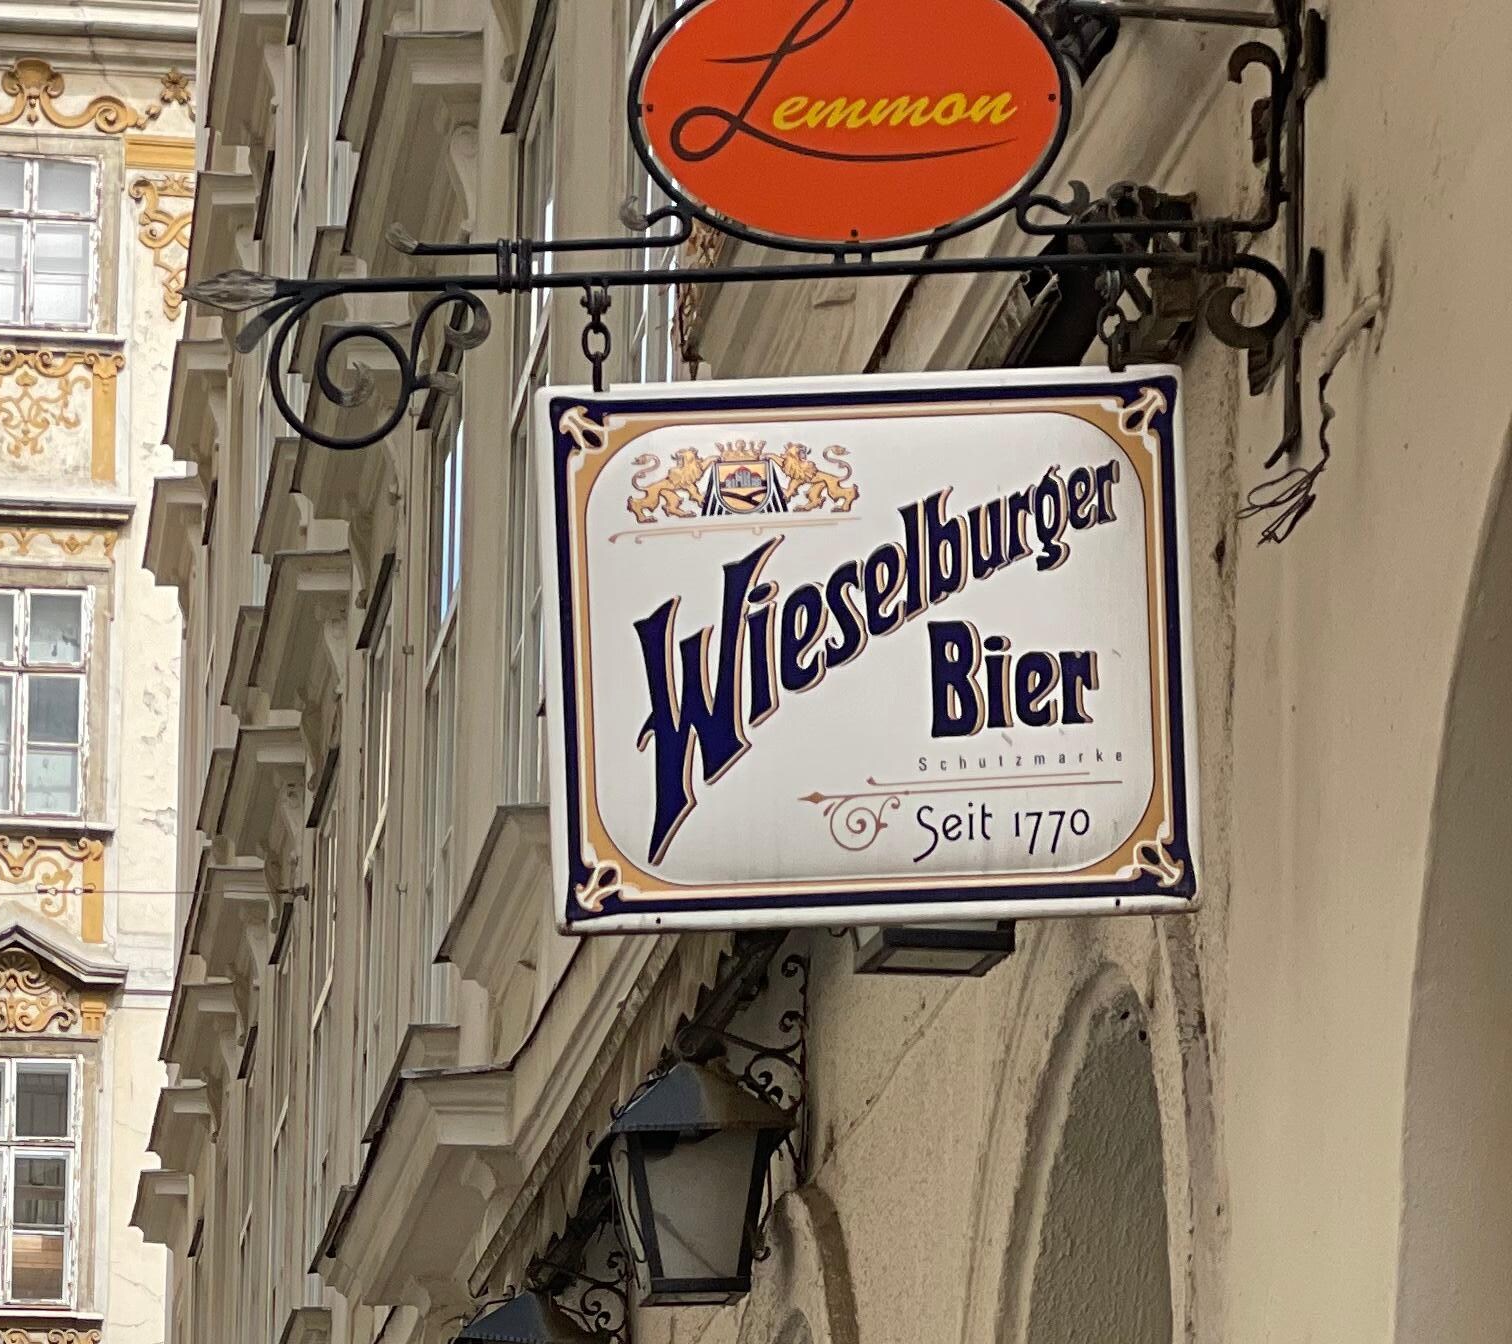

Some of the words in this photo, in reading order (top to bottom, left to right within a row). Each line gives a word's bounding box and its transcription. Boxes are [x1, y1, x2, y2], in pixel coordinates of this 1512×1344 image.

[669, 0, 1019, 163] Lemmon
[635, 456, 1122, 867] Wieselburger
[926, 619, 1101, 739] Bier
[918, 748, 1124, 772] Schutzmarke
[912, 801, 994, 863] Seit
[1012, 807, 1092, 856] 1770
